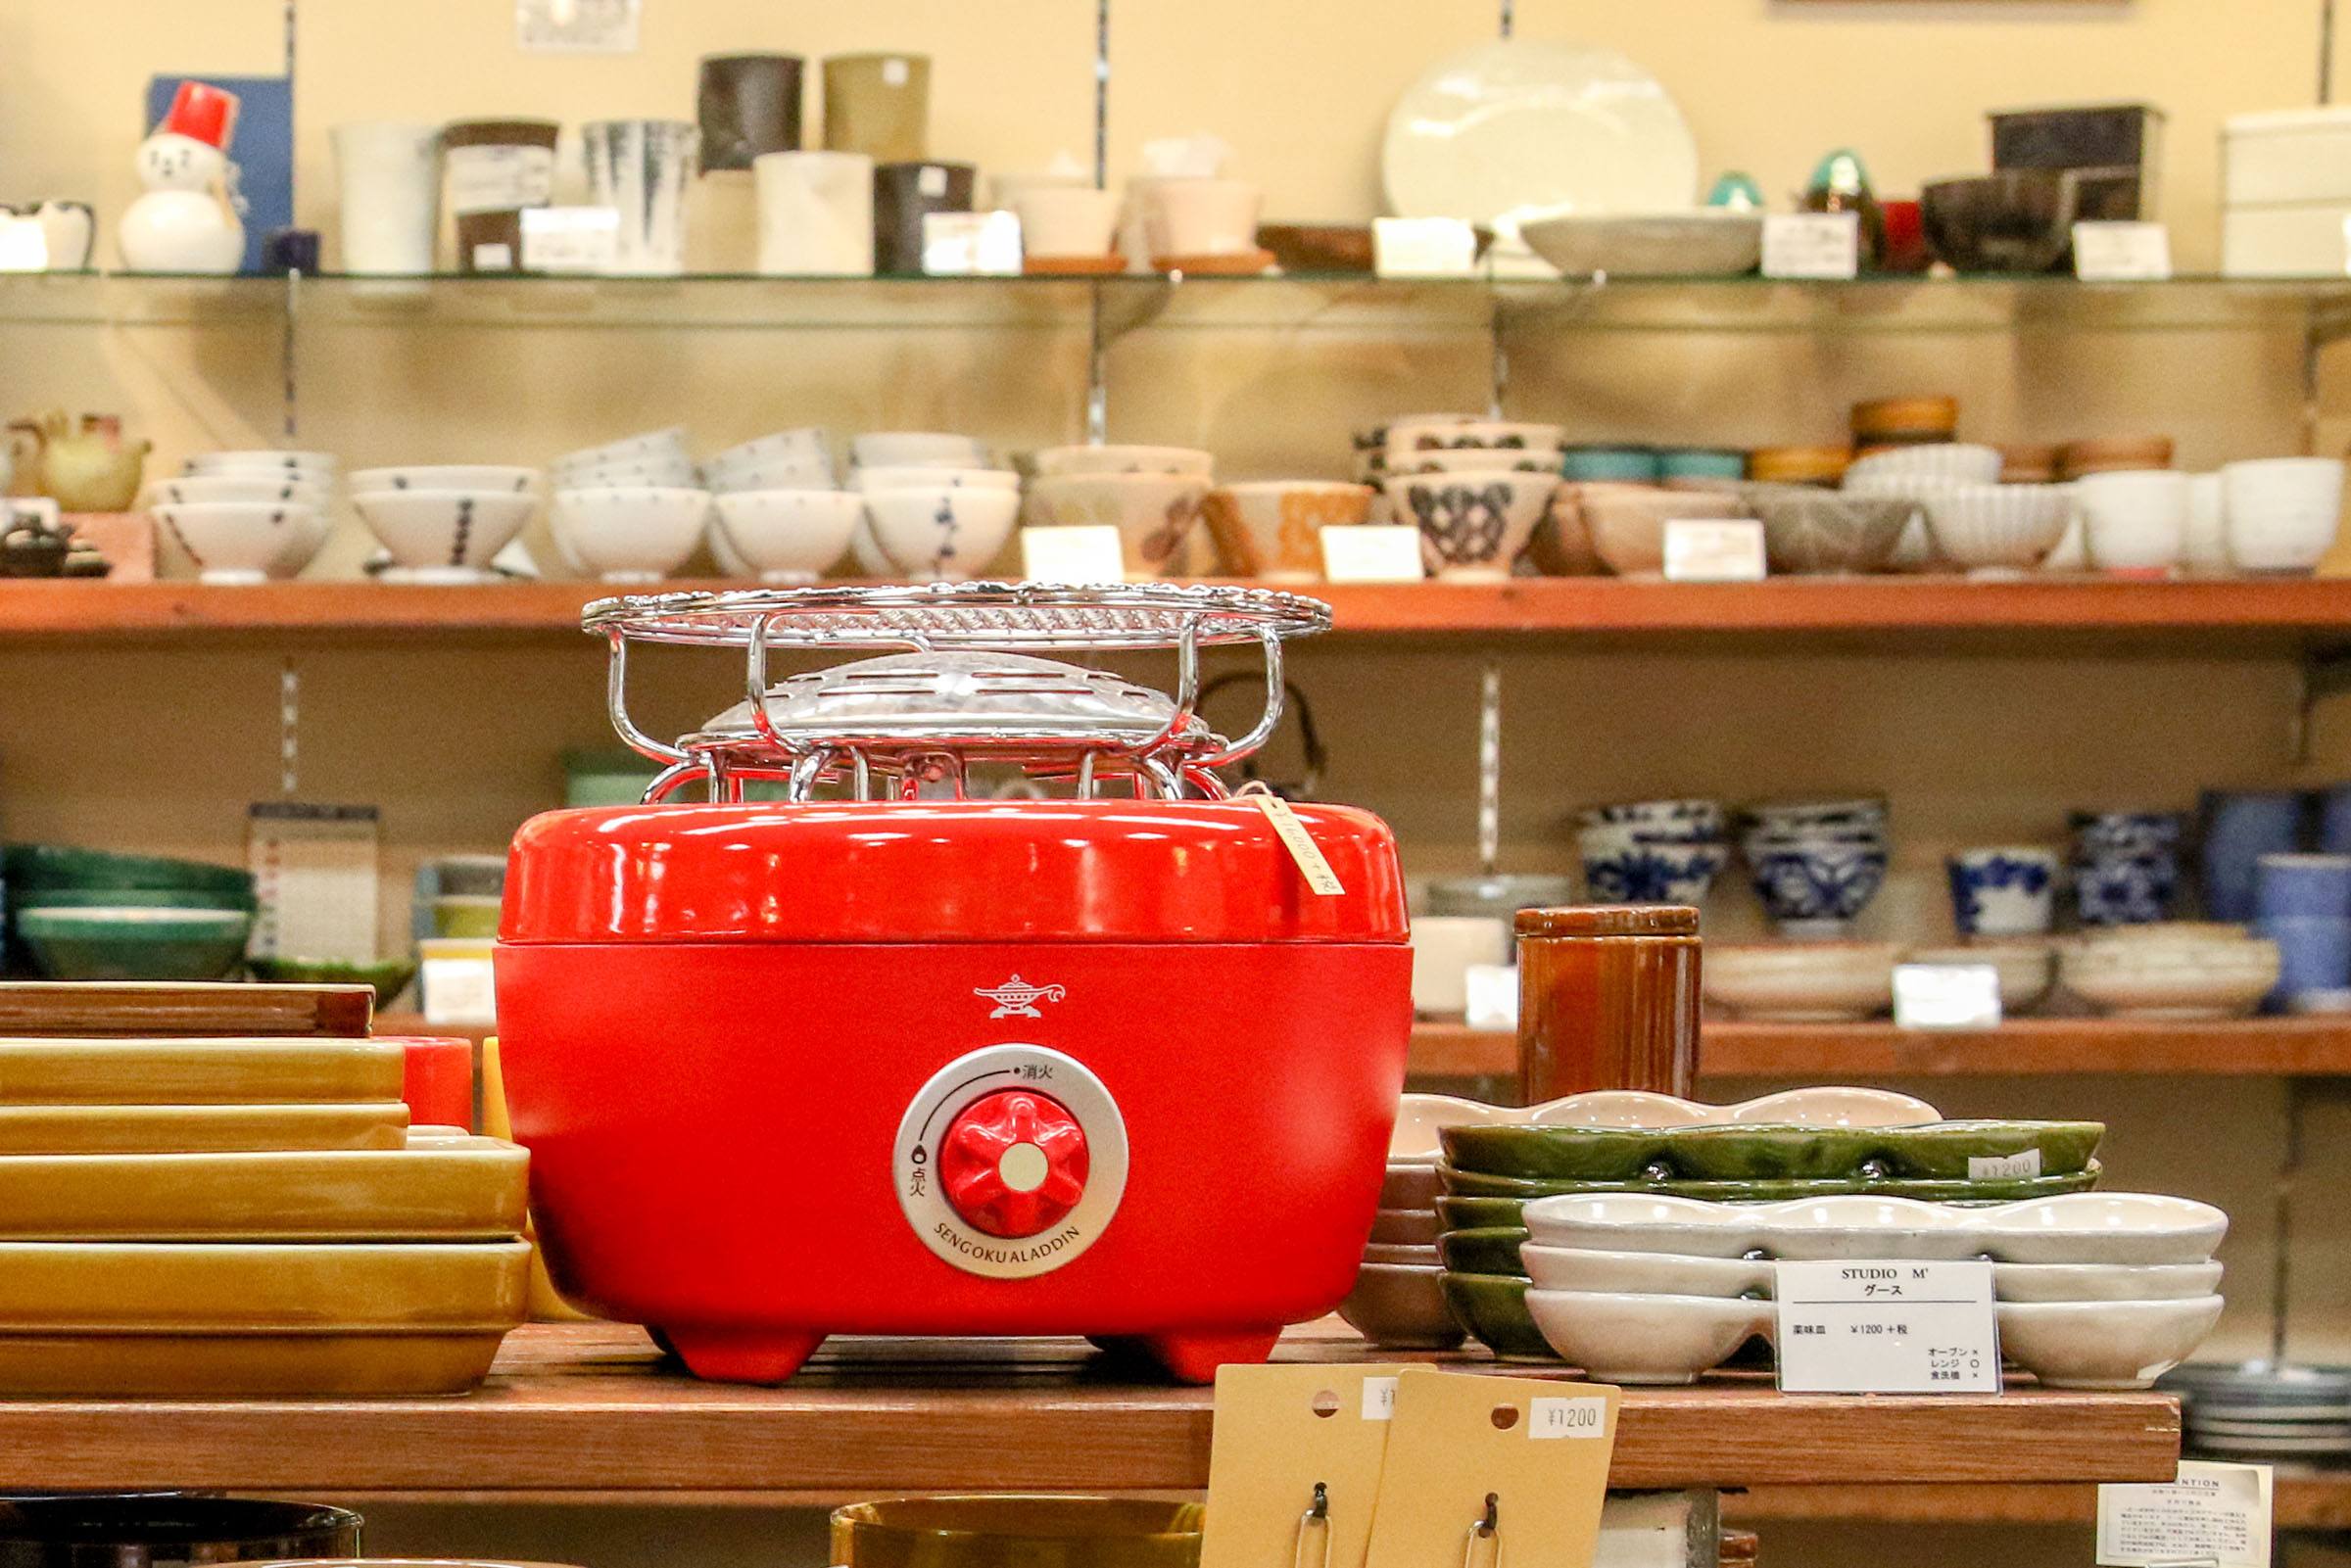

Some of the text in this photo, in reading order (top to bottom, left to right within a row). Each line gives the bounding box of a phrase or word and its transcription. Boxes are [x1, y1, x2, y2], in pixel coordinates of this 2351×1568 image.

[1022, 1064, 1053, 1079] 消火
[910, 1167, 926, 1197] 点火
[1842, 1268, 1897, 1280] STUDIO
[1864, 1284, 1902, 1296] グース
[1931, 1359, 1959, 1368] レンジ
[1549, 1407, 1597, 1427] ¥1200
